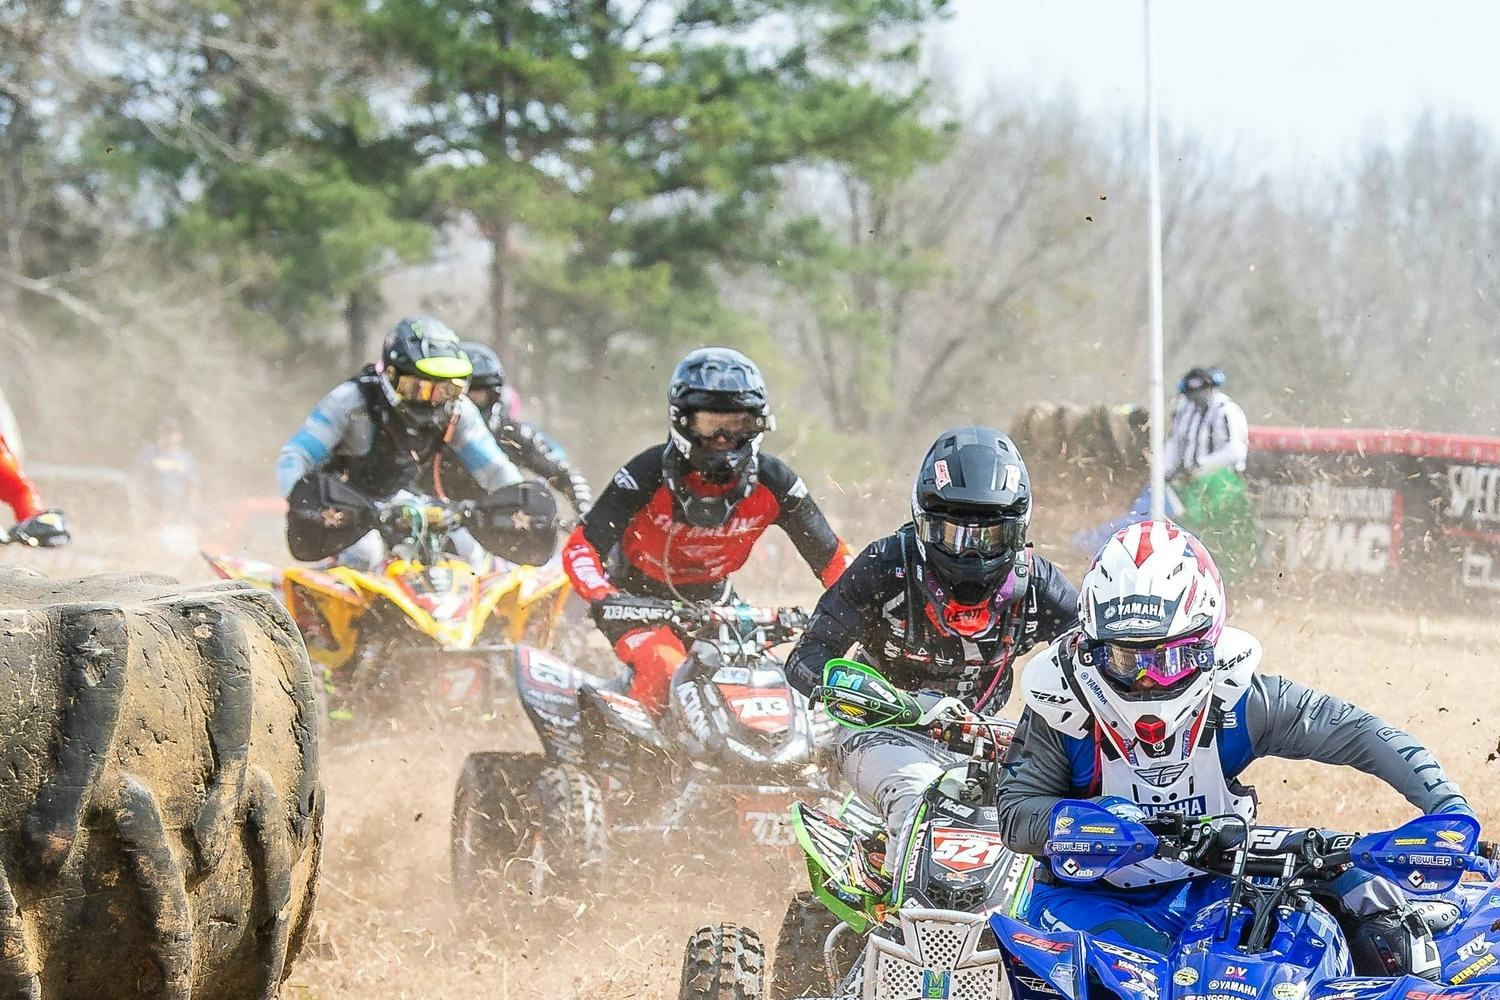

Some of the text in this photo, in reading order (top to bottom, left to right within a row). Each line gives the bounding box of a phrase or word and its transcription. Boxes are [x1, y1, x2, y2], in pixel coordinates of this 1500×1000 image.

[1119, 601, 1166, 618] YAMAHA
[1085, 676, 1108, 706] YAMAHA
[1052, 842, 1090, 852] FOWLER
[1409, 854, 1452, 866] FOWLER
[1011, 932, 1074, 952] GBC
[1219, 980, 1258, 997] YAMAHA
